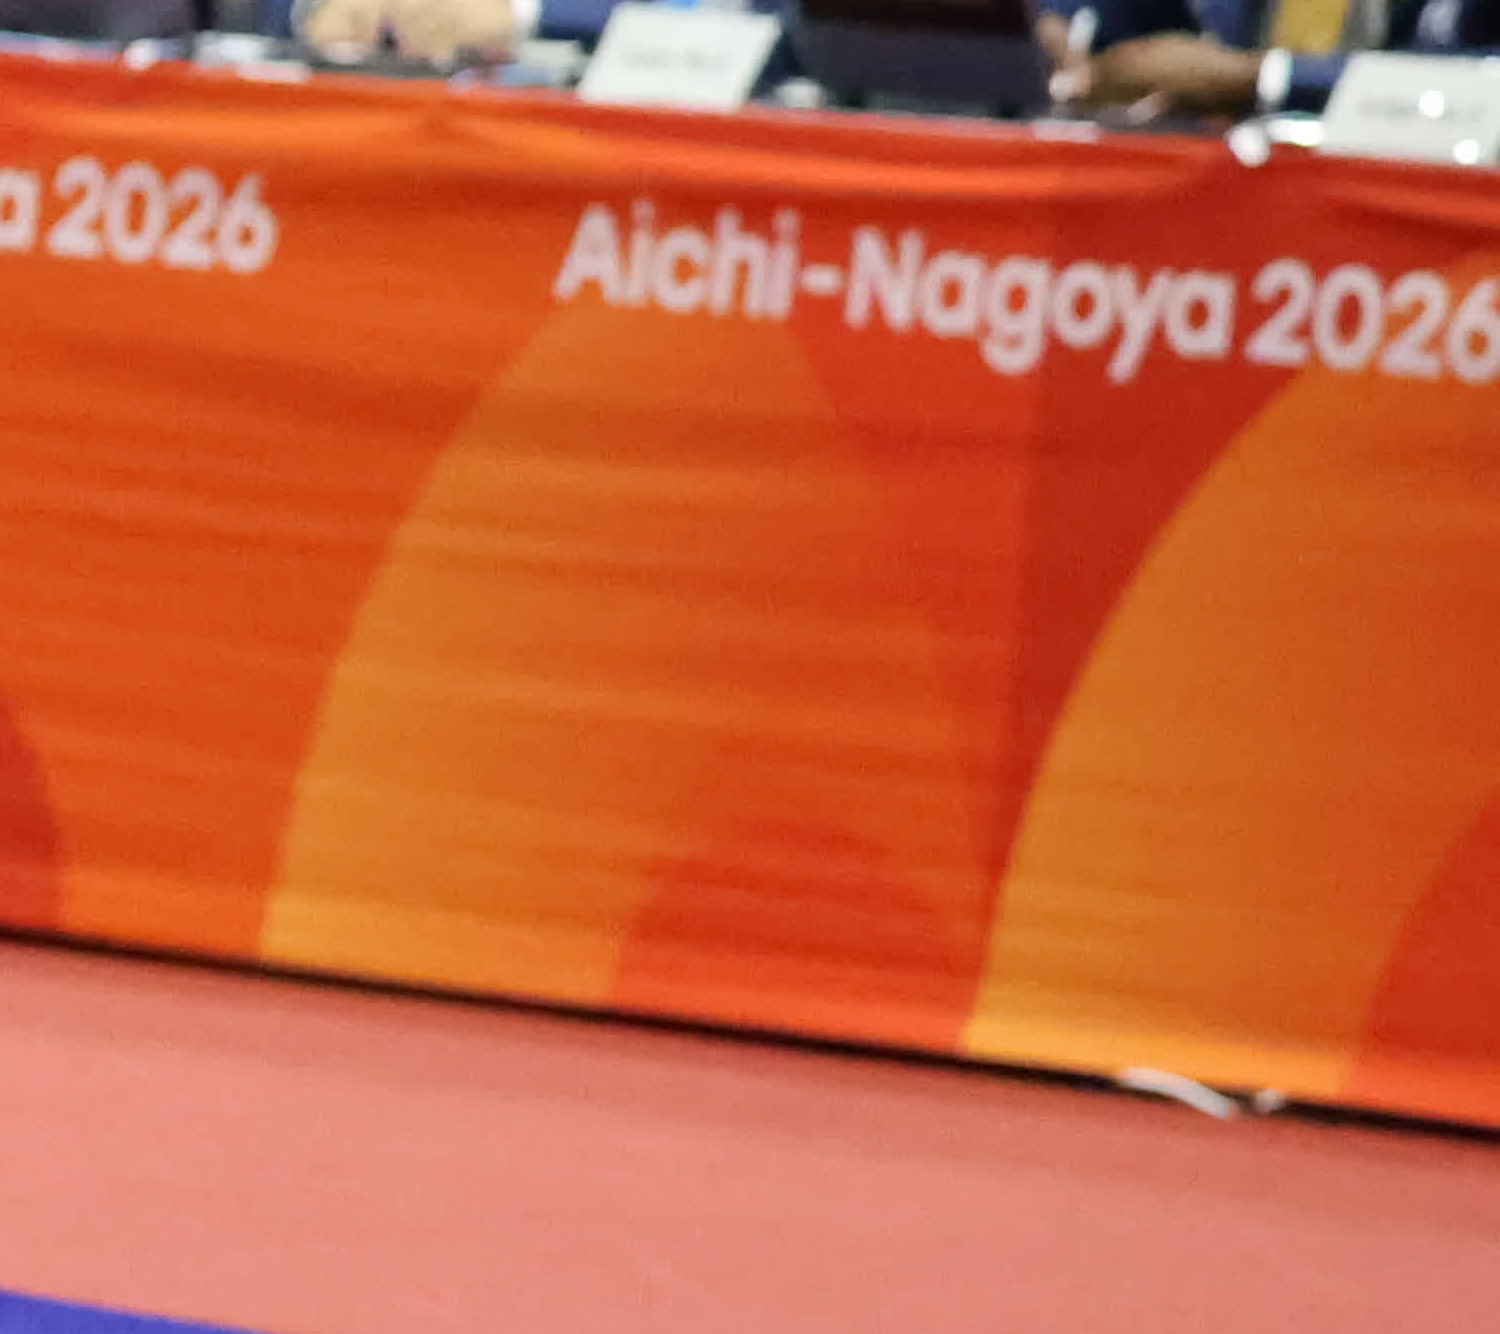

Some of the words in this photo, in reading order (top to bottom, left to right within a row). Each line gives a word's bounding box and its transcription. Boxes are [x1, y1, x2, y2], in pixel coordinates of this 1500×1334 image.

[46, 155, 279, 275] 2026
[555, 196, 1237, 384] Aichi-Nagoya
[1243, 254, 1500, 387] 2026
